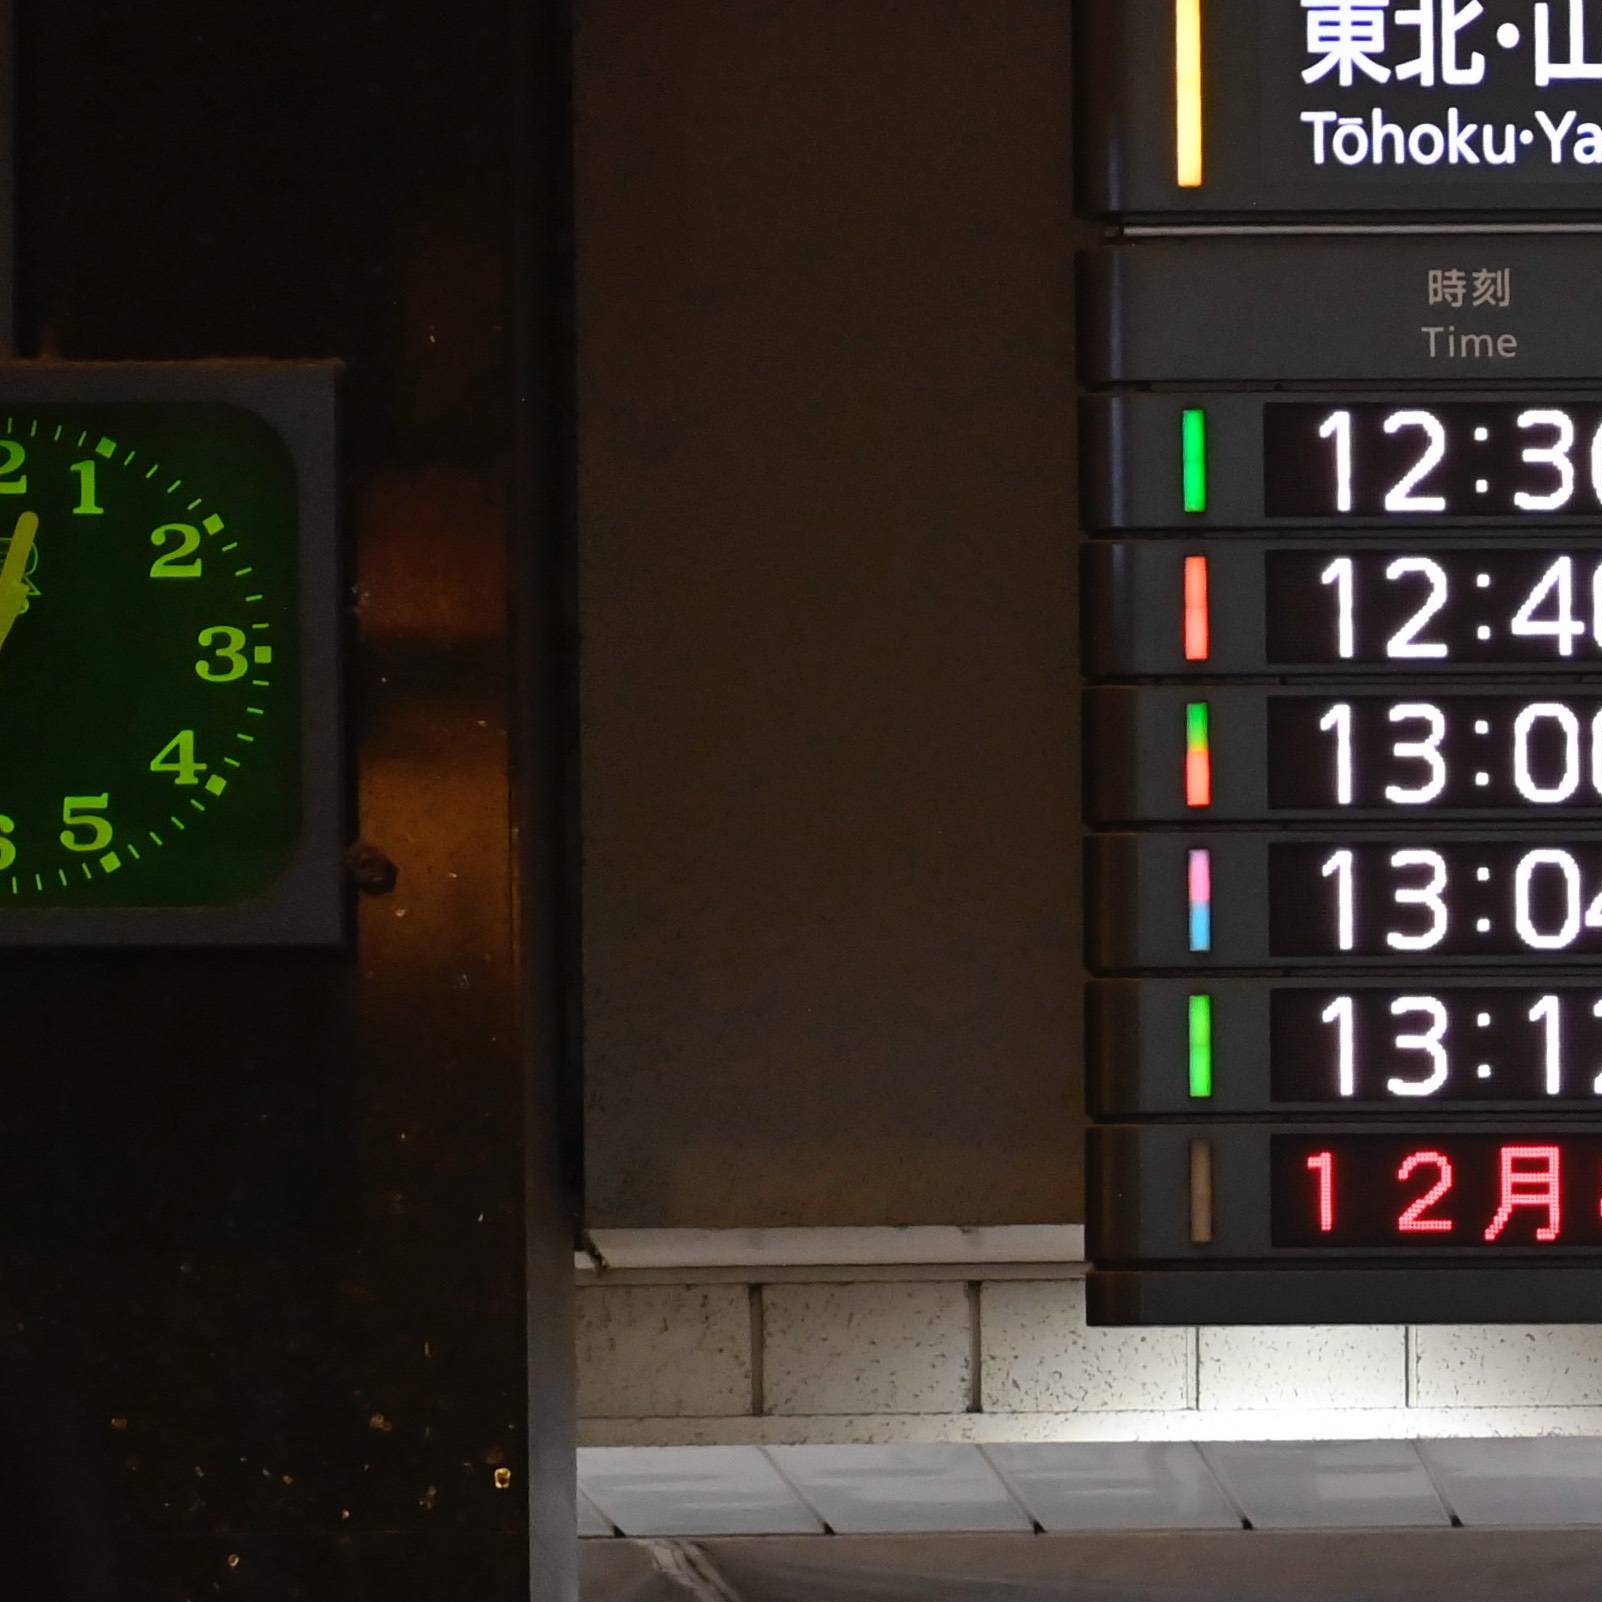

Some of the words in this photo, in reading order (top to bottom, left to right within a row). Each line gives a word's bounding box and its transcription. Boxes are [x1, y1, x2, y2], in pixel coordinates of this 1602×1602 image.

[1428, 267, 1511, 308] 時刻
[1420, 325, 1518, 358] Time
[70, 459, 104, 514] 1
[149, 522, 203, 578] 2
[195, 625, 249, 682] 3
[150, 729, 208, 785] 4
[59, 792, 114, 851] 5
